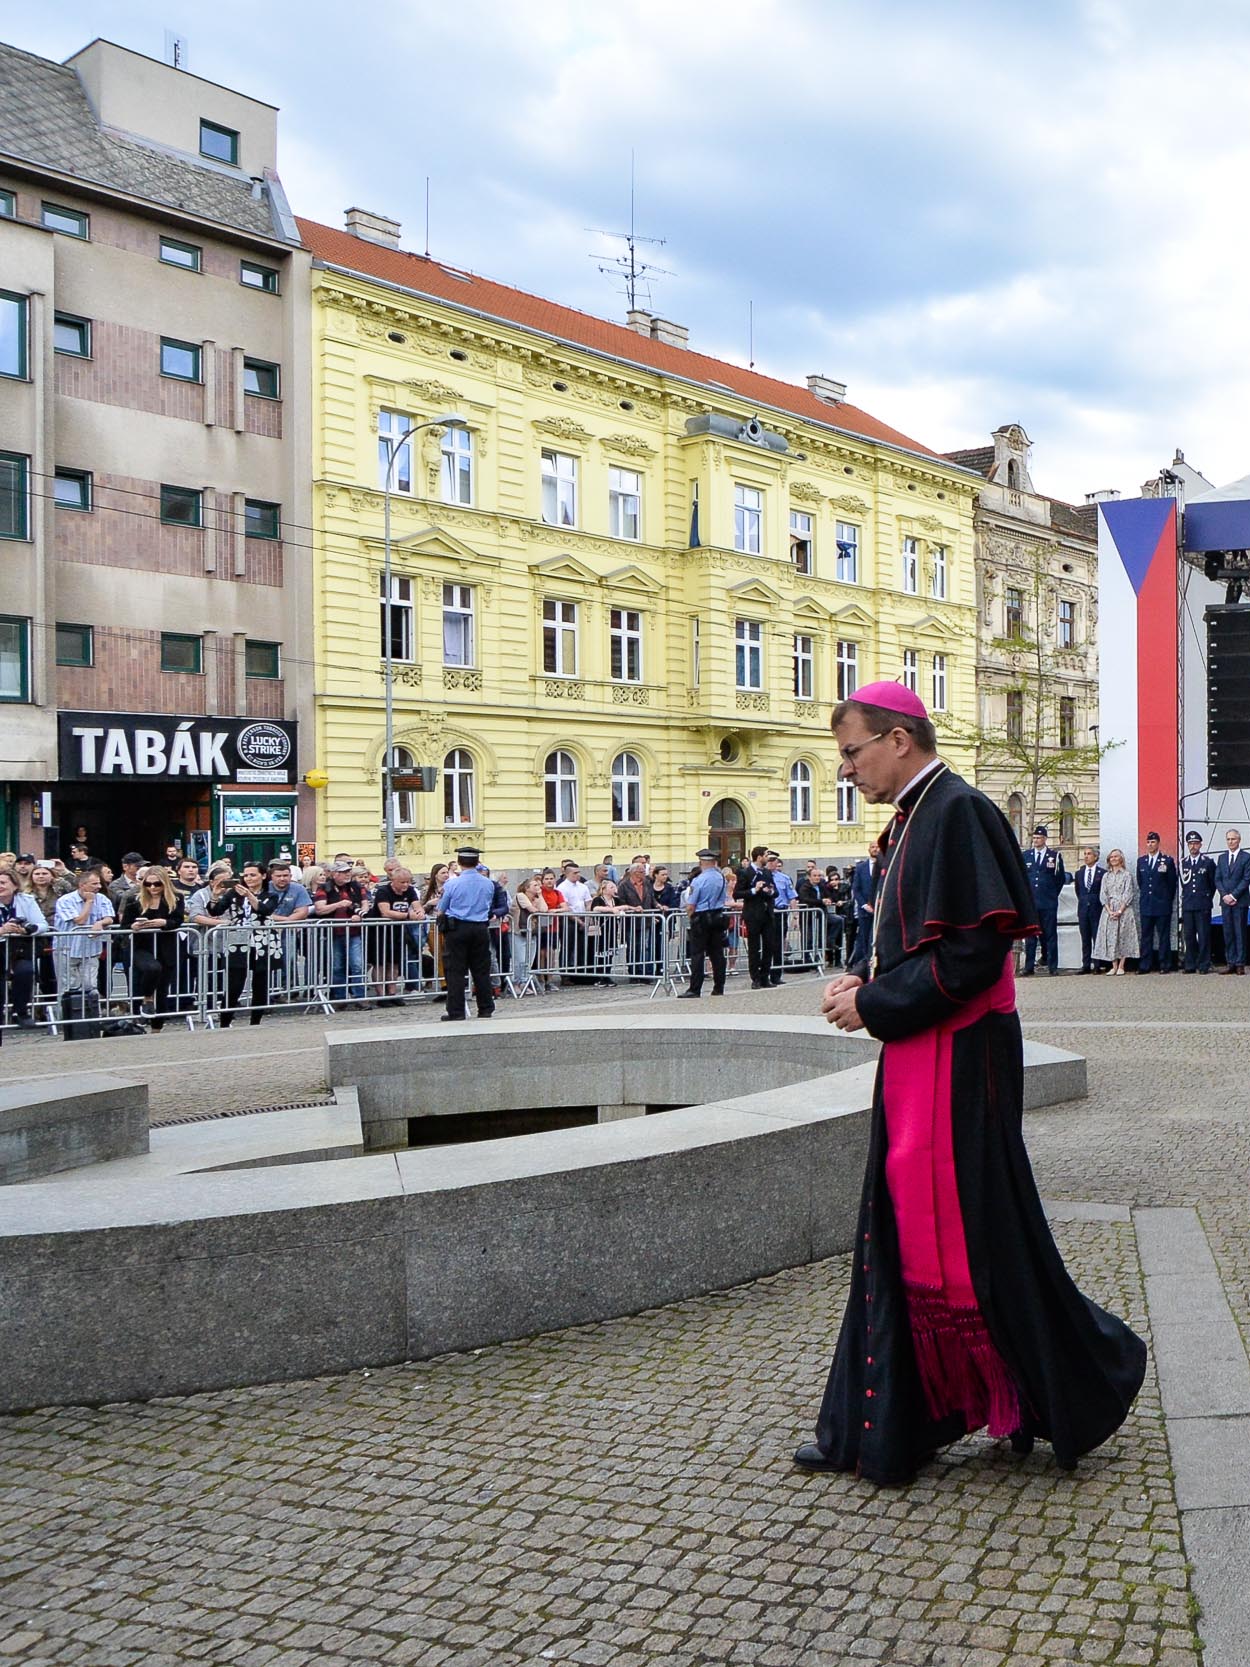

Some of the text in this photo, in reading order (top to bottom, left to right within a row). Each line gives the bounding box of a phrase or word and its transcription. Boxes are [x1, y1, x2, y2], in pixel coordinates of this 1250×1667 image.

[250, 736, 281, 746] LUCKY
[72, 722, 231, 776] TABÁK
[248, 744, 282, 754] STRIKE
